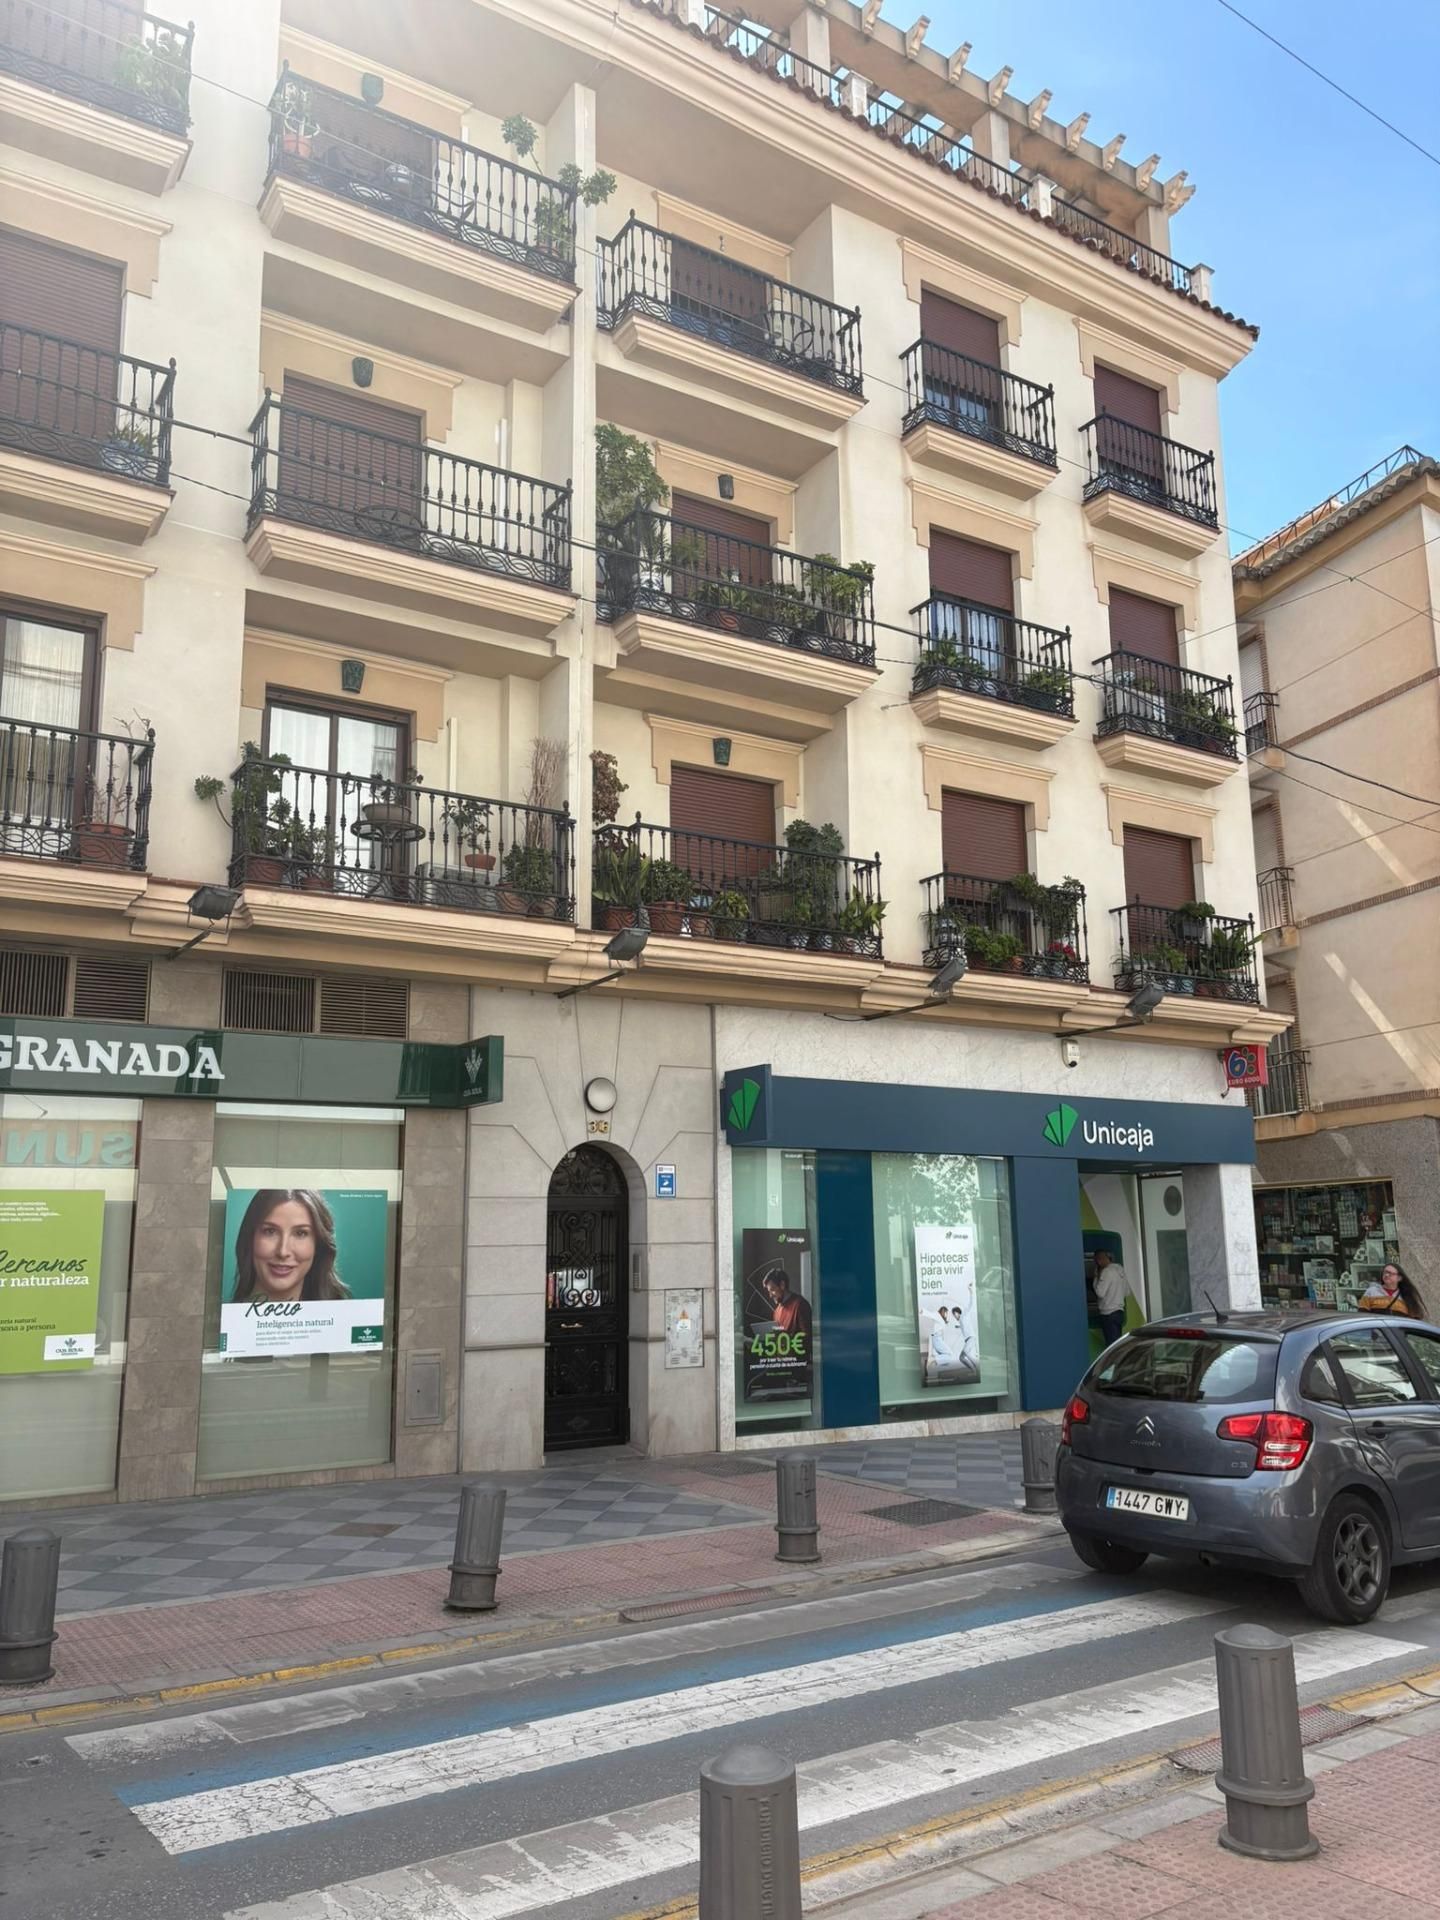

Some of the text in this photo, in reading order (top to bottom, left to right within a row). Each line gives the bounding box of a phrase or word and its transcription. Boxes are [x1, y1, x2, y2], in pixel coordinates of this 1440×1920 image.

[1083, 1120, 1154, 1152] Unicaja
[920, 1252, 969, 1266] Hipotecas
[921, 1264, 964, 1279] para vivir
[10, 1272, 89, 1287] naturaleza
[921, 1279, 943, 1289] bien
[256, 1318, 334, 1330] Inteligencia natural
[751, 1331, 806, 1357] 450€
[1117, 1490, 1183, 1517] 1447 GWY
